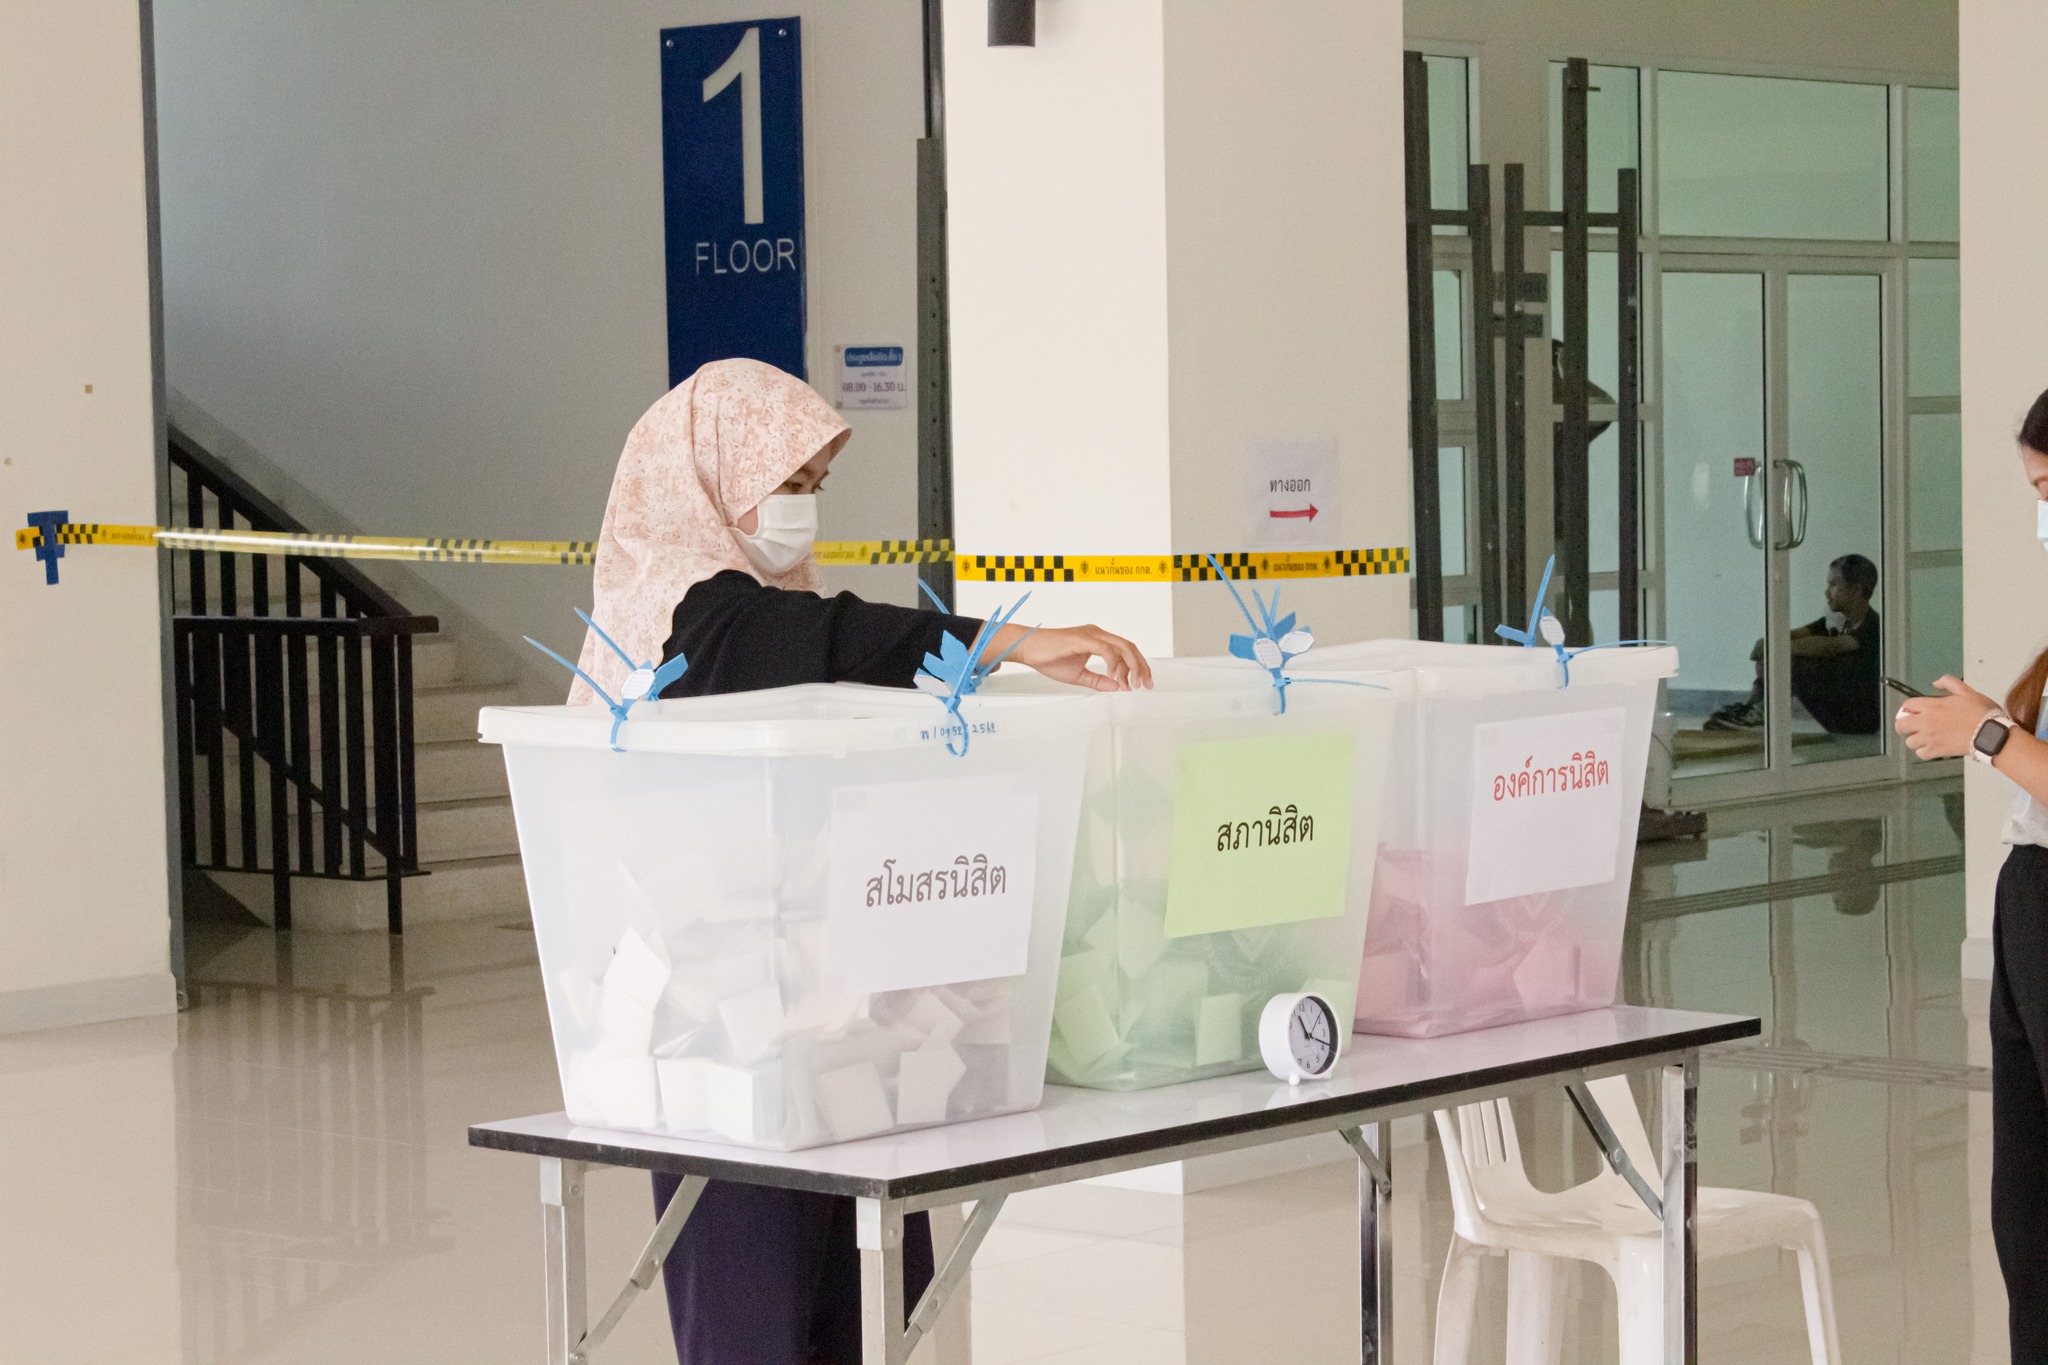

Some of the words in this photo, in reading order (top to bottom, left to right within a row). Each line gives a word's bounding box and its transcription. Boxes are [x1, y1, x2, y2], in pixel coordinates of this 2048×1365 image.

[702, 26, 764, 224] 1
[696, 238, 796, 275] FLOOR
[873, 381, 895, 392] 16.30
[1269, 478, 1311, 492] ทางออก
[1493, 750, 1609, 801] องค์การนิสิต
[1217, 804, 1314, 852] สภานิสิต
[866, 853, 1006, 908] สโมสรนิสิต
[1298, 1003, 1305, 1012] 12
[1322, 1029, 1326, 1037] 3
